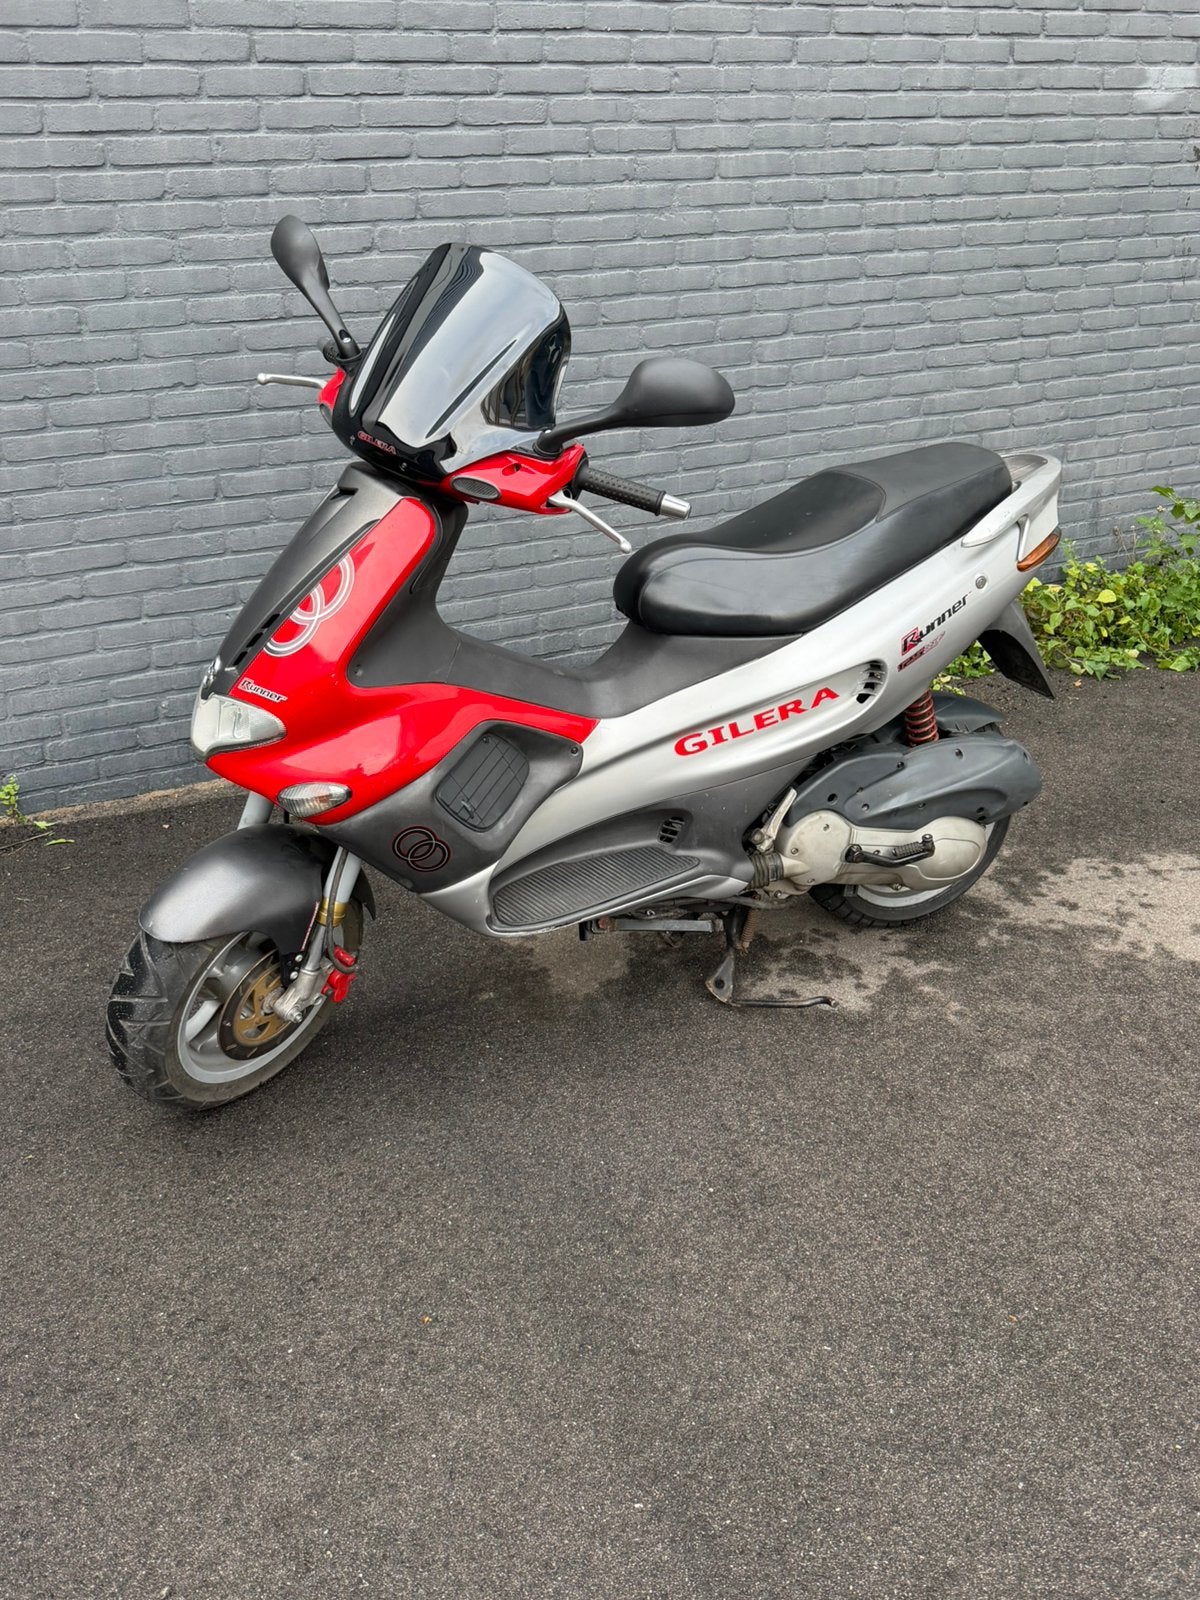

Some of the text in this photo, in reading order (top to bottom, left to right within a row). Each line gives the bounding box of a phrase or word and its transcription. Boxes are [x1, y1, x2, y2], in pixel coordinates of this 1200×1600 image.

[901, 591, 971, 656] Runner
[238, 677, 286, 702] Runner
[674, 687, 840, 756] GILERA
